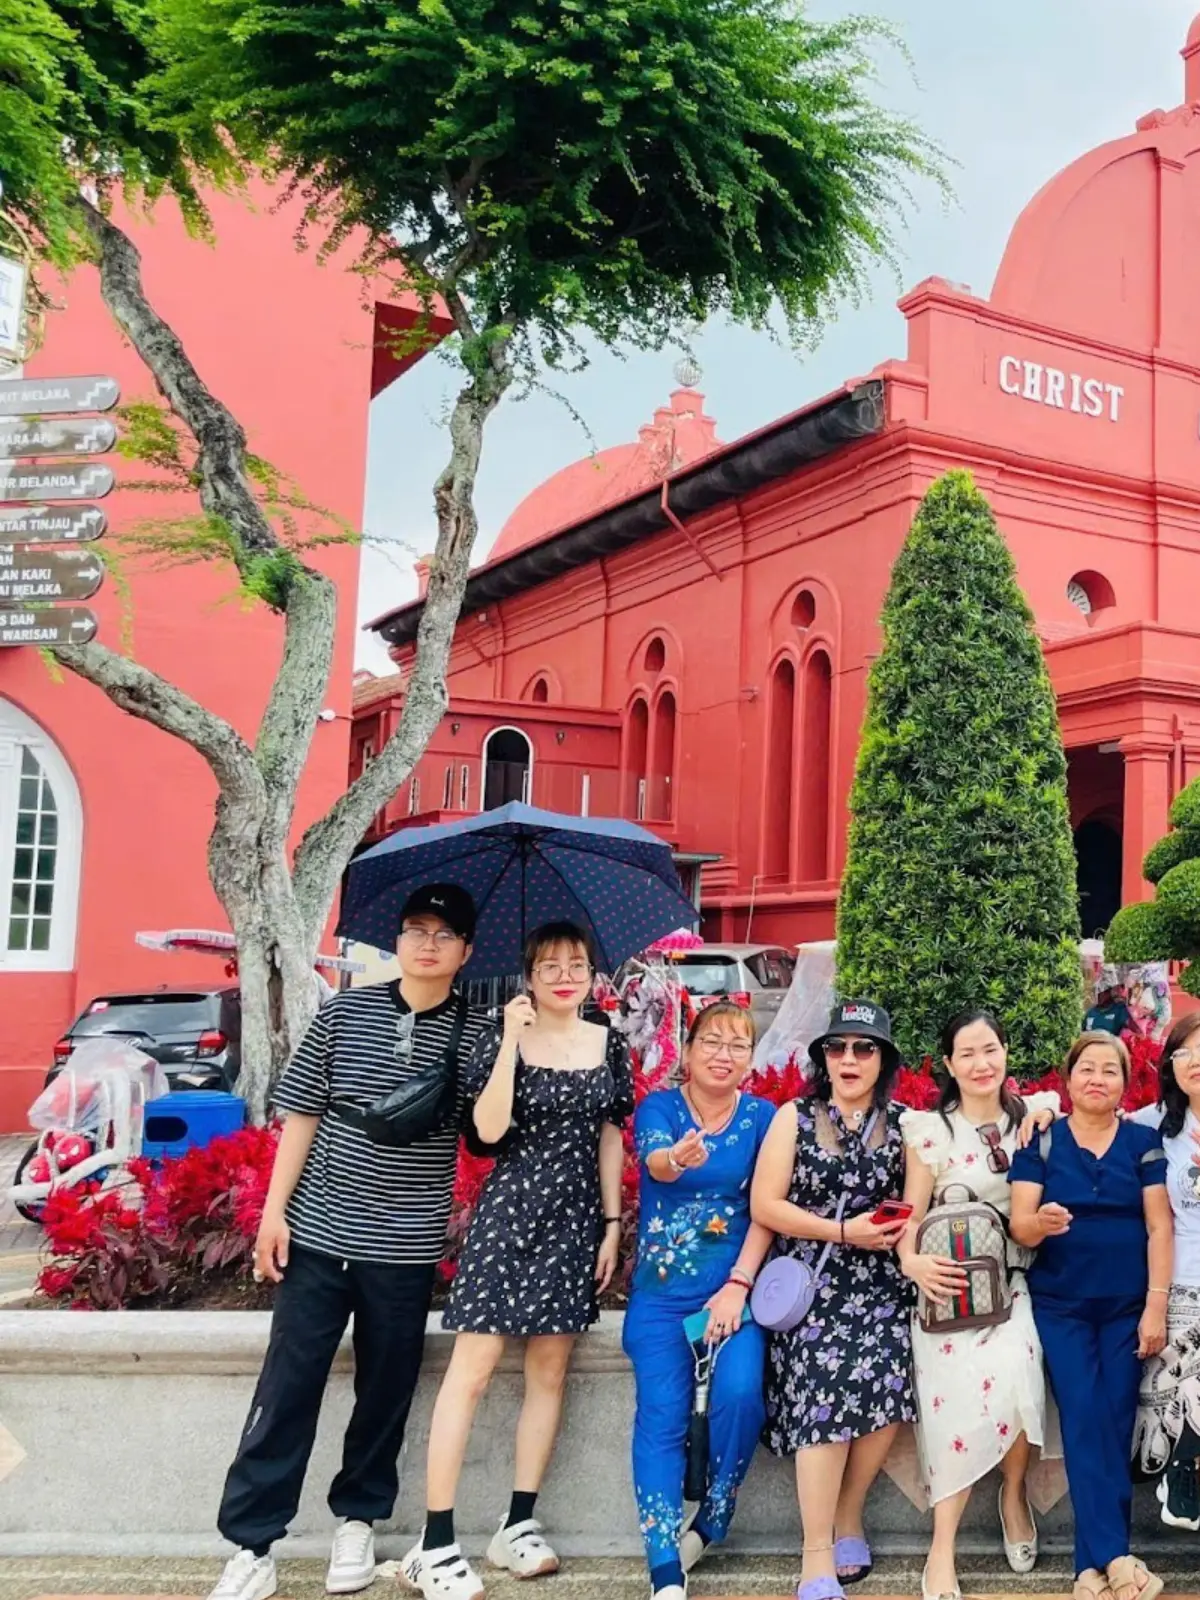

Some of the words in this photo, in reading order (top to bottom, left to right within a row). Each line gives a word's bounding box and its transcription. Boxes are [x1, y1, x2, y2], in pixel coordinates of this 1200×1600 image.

[21, 388, 71, 401] MELAKA
[999, 355, 1124, 422] CHRIST
[19, 475, 76, 488] BELANDA
[29, 517, 71, 530] TINJAU
[22, 568, 52, 580] KAKI
[12, 583, 62, 596] MELAKA
[10, 613, 36, 626] DAN
[2, 628, 58, 641] WARISAN
